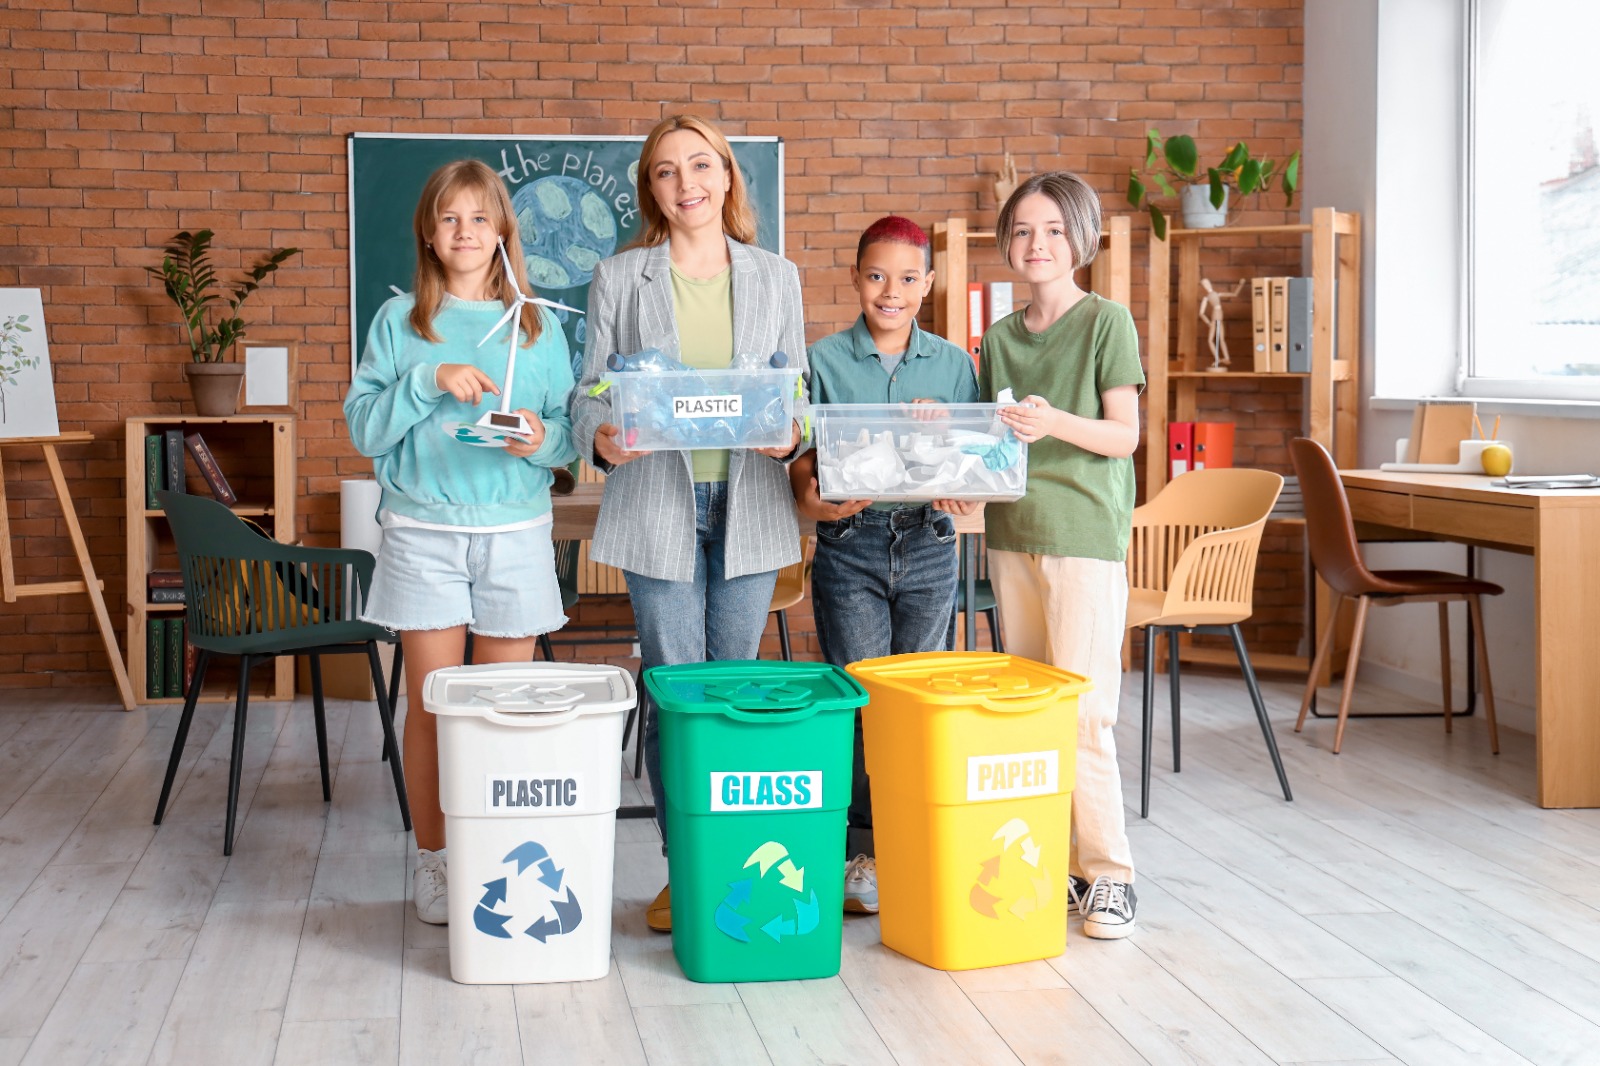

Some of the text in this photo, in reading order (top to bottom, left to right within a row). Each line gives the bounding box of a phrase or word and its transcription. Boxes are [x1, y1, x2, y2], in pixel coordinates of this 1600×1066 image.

[497, 143, 639, 228] the planet
[675, 399, 738, 413] PLASTIC
[722, 775, 811, 805] GLASS
[978, 759, 1047, 791] PAPER
[493, 778, 577, 807] PLASTIC
